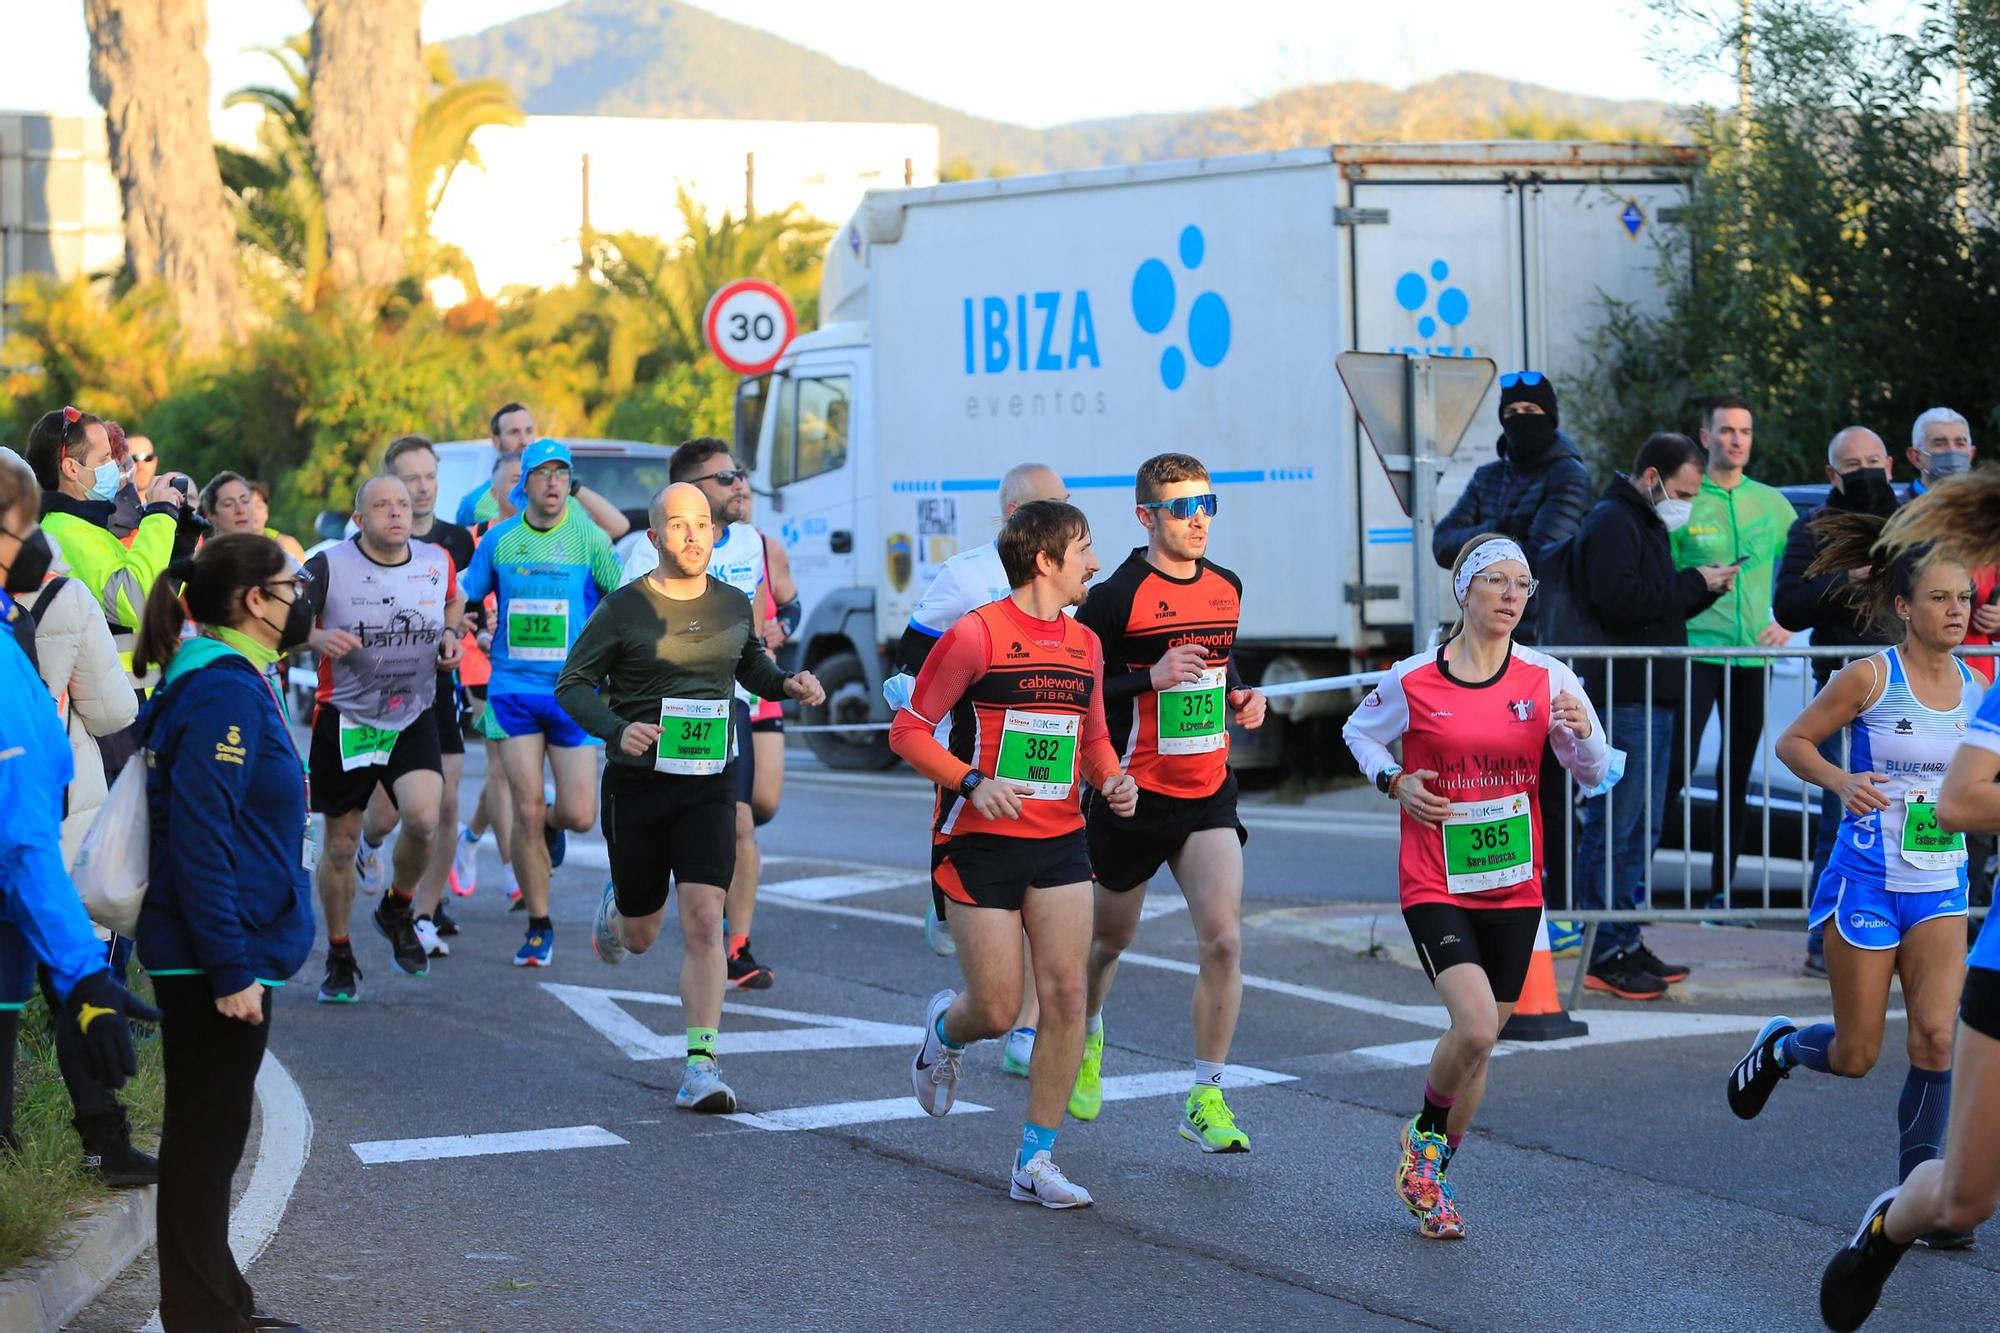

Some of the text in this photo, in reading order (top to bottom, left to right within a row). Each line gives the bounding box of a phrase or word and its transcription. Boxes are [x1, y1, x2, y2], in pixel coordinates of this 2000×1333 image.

[729, 314, 774, 342] 30
[964, 290, 1100, 374] IBIZA
[966, 388, 1106, 419] eventos
[1155, 611, 1177, 619] VIATOR
[523, 617, 550, 633] 312
[1168, 631, 1233, 649] cableworld
[1019, 674, 1085, 692] cableworld
[1035, 691, 1074, 701] FIBRA
[1182, 693, 1213, 717] 375
[681, 721, 712, 741] 347
[1024, 737, 1059, 761] 382
[1432, 754, 1465, 773] Abel
[1886, 759, 1921, 773] BLUE
[1028, 766, 1050, 780] NICO
[1470, 824, 1510, 851] 365
[1915, 834, 1938, 845] Esther
[1466, 855, 1487, 868] Sara
